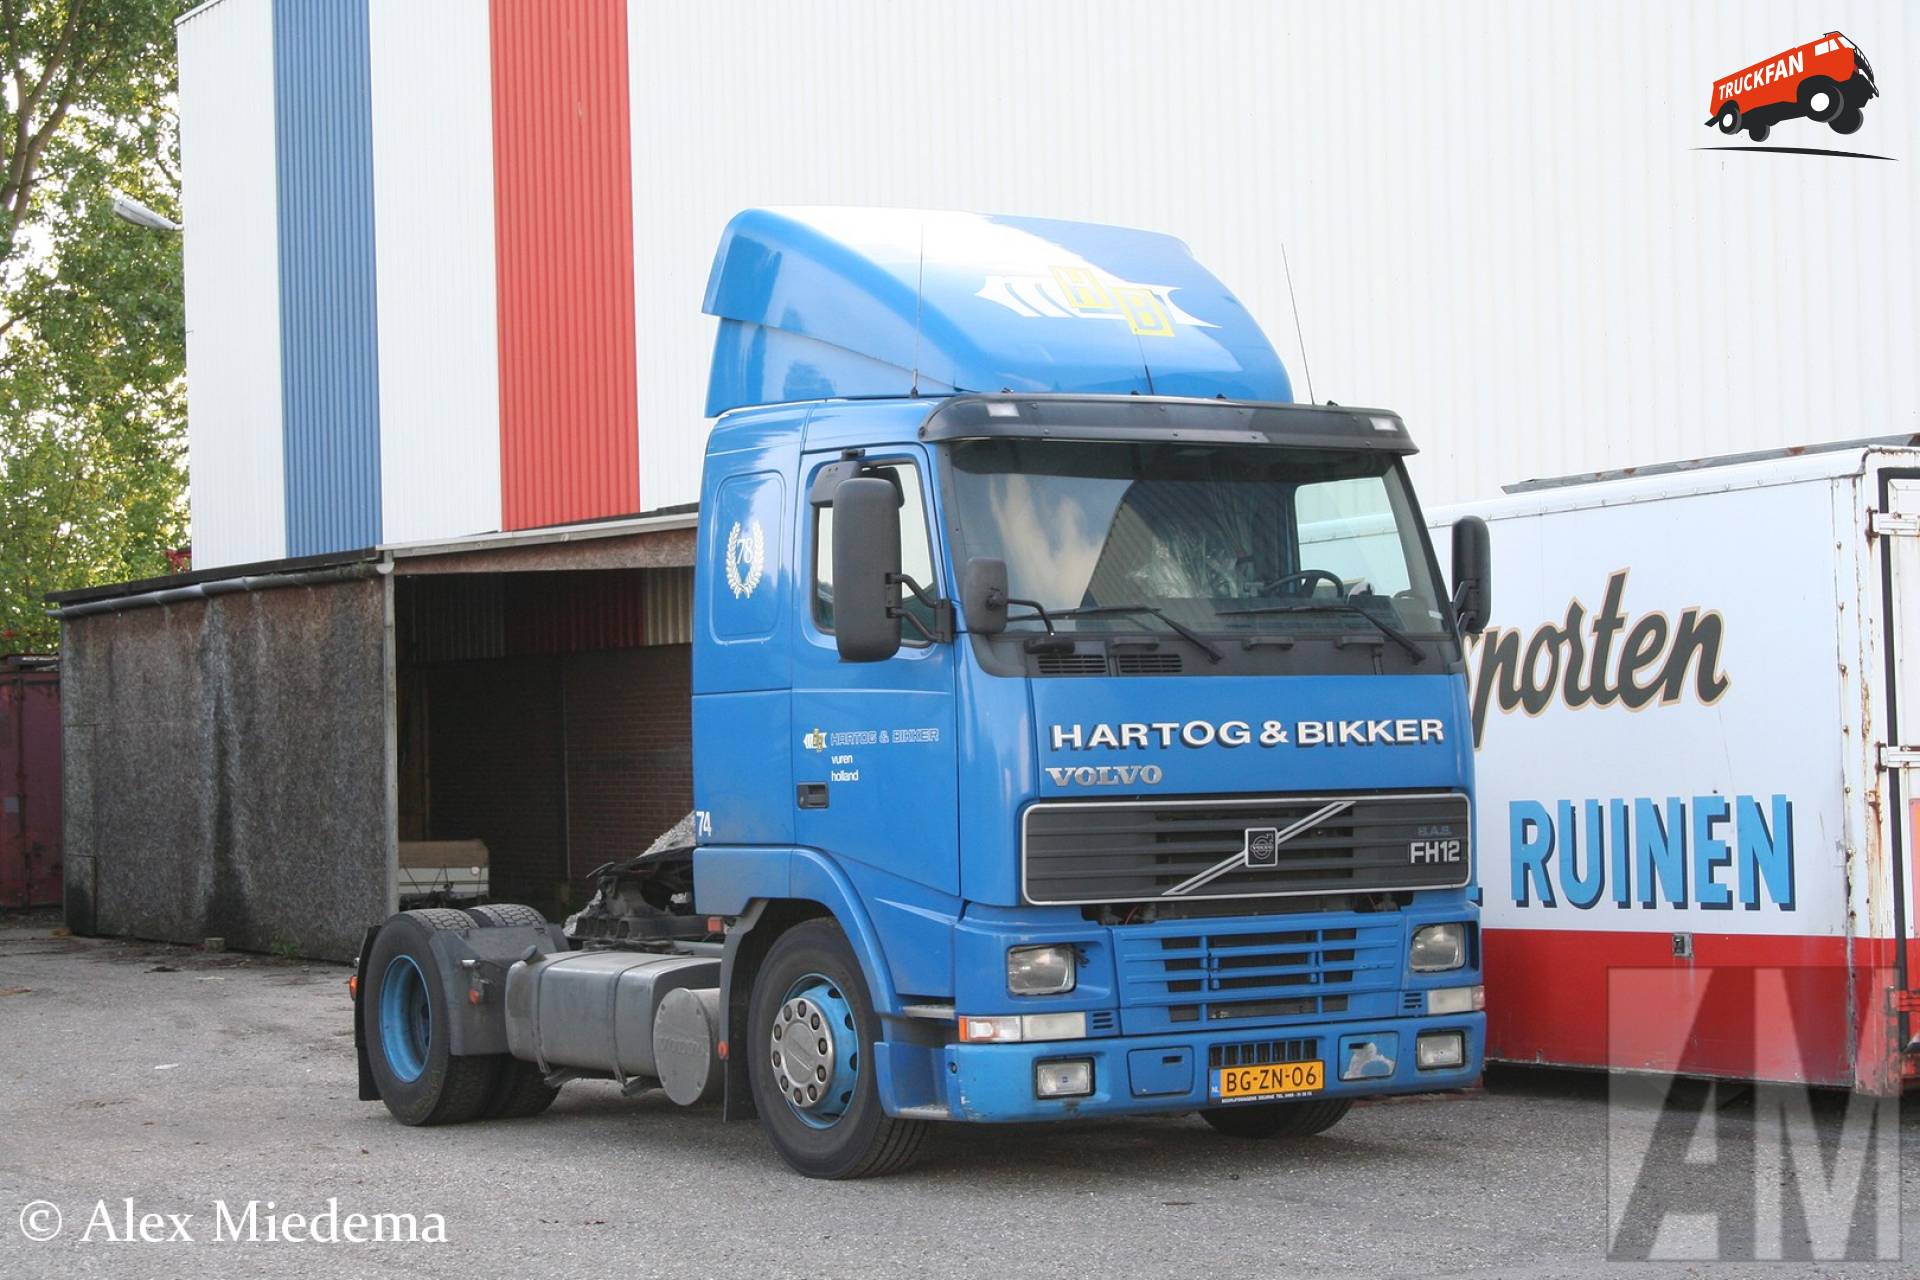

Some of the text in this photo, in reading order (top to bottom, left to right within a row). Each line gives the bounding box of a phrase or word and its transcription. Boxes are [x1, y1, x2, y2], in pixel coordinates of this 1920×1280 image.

[736, 538, 753, 564] 78
[1463, 567, 1732, 751] porten
[830, 731, 877, 746] HARTOG
[879, 730, 890, 744] &
[892, 728, 940, 743] BIKKER
[1052, 718, 1445, 750] HARTOG & BIKKER
[831, 754, 853, 765] vuren
[831, 770, 859, 782] holland
[1045, 765, 1163, 787] VOLVO
[696, 811, 712, 837] 74
[1410, 841, 1460, 864] FH12
[1508, 794, 1796, 911] RUINEN
[1226, 1066, 1317, 1092] BG-ZN-06
